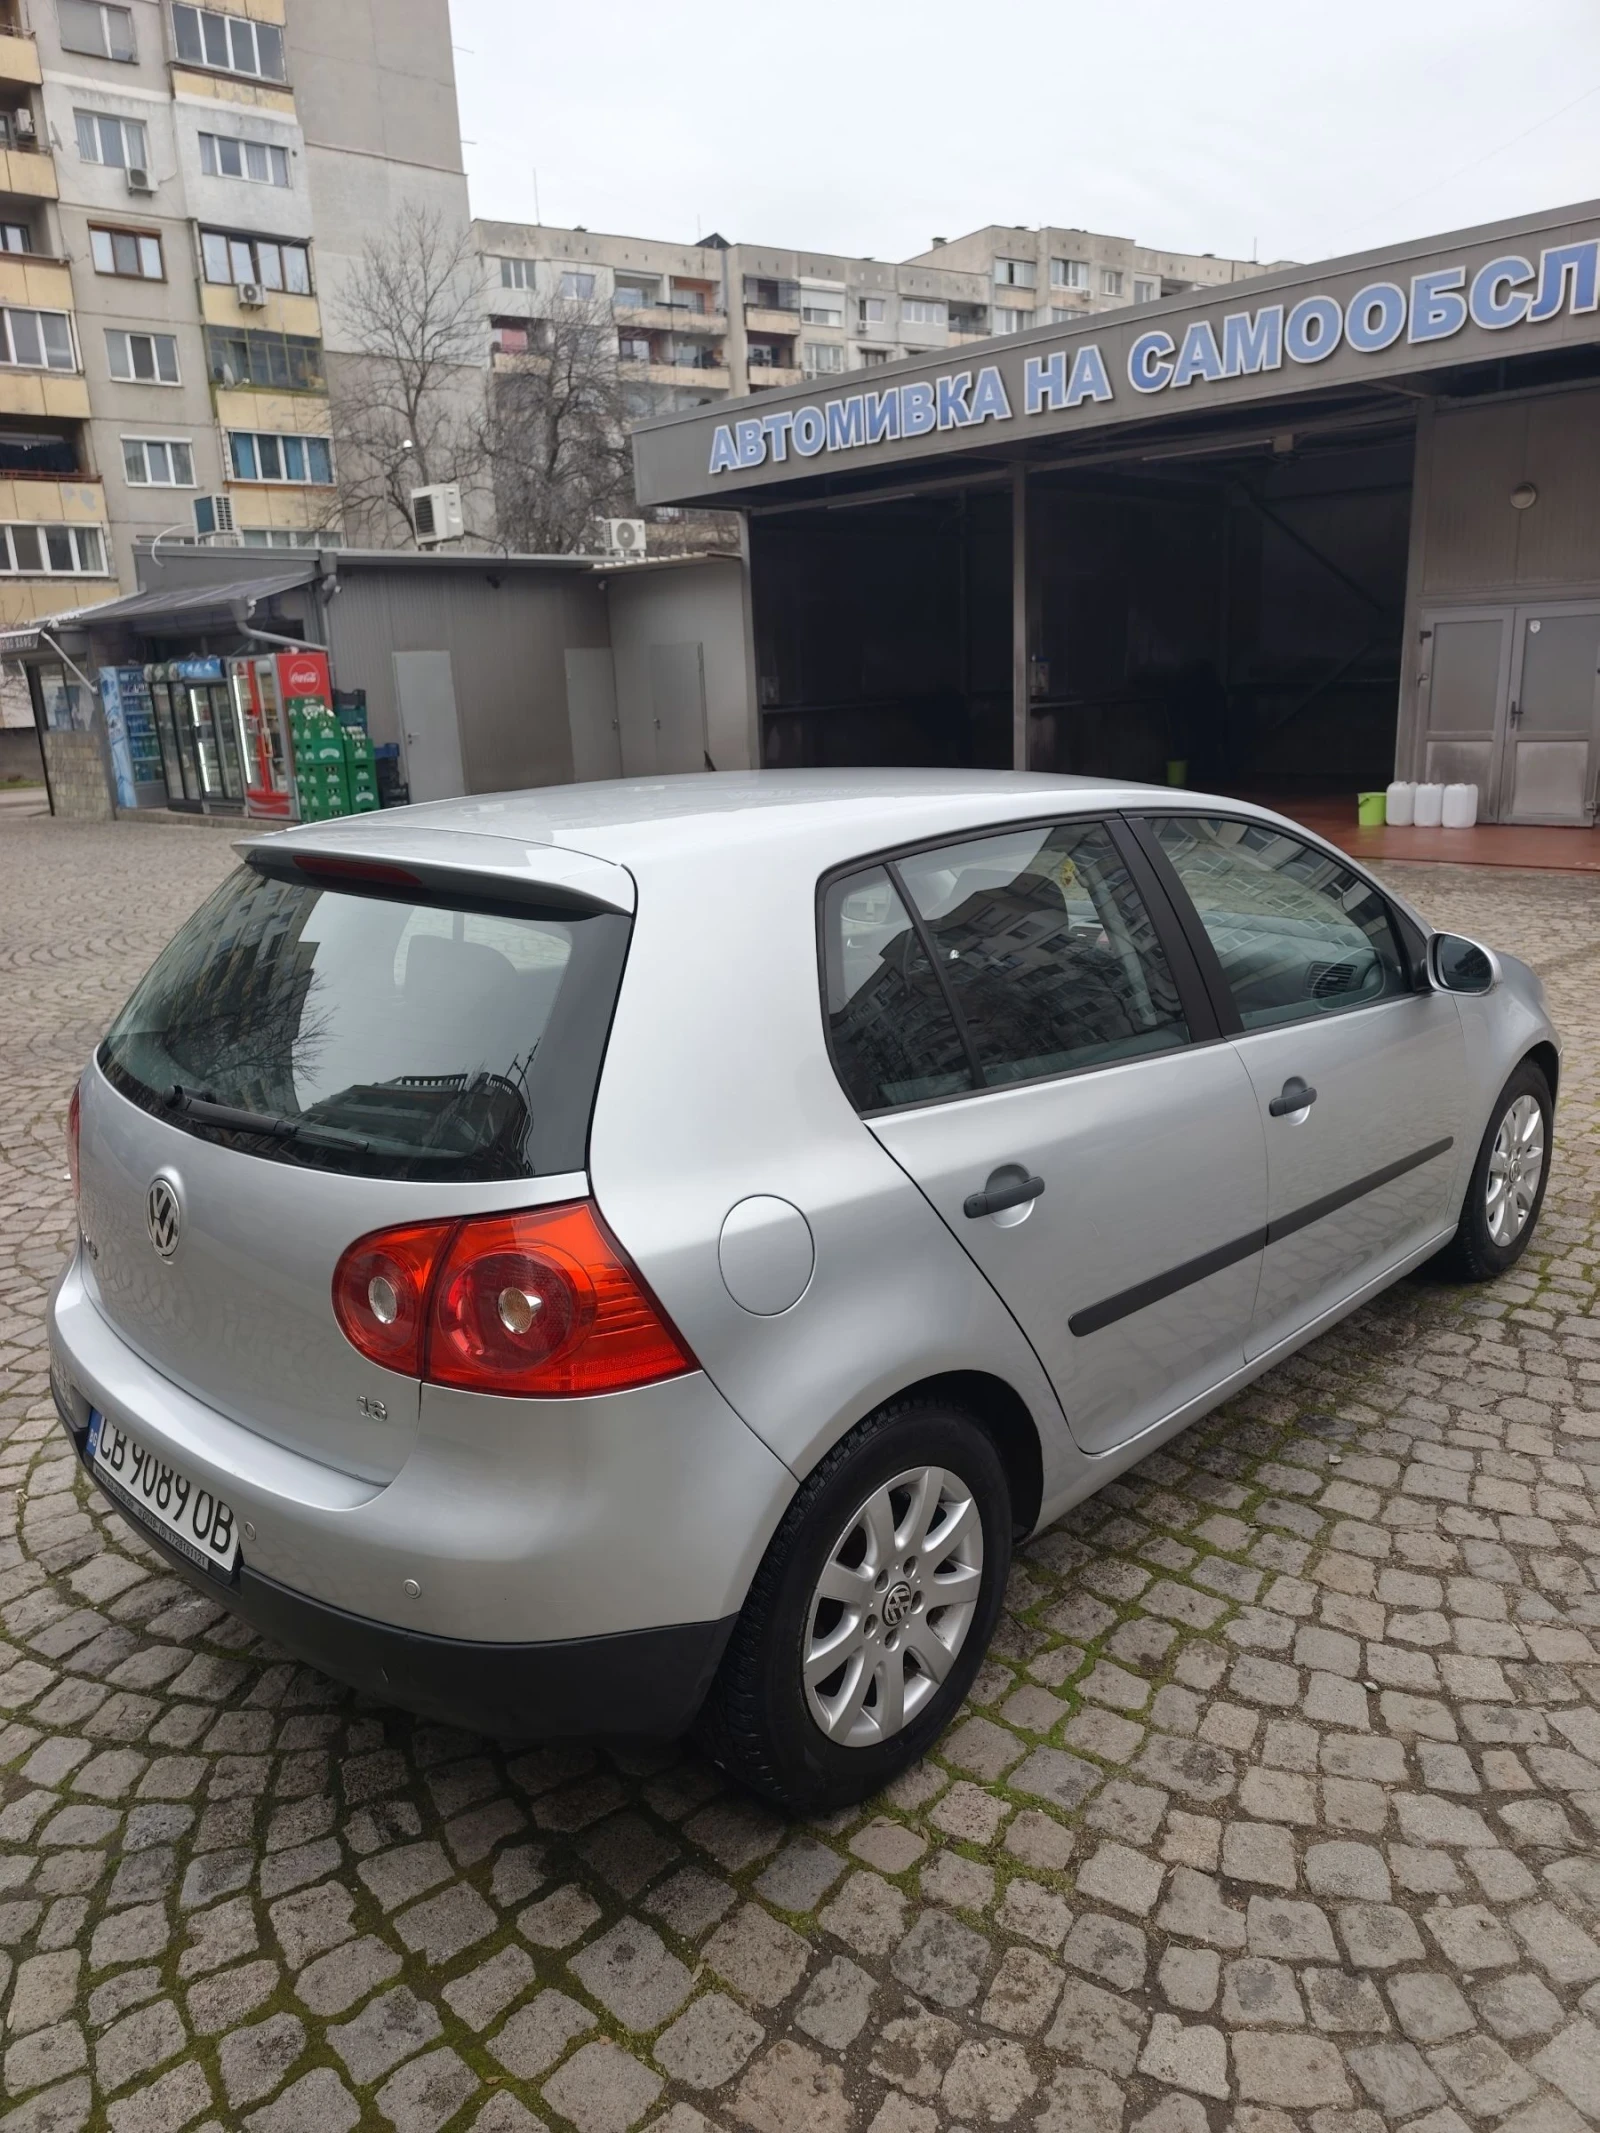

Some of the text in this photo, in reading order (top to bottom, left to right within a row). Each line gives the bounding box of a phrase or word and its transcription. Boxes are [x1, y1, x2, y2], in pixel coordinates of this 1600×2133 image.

[709, 238, 1600, 474] АВТОМИВКА НА САМООБСЛ
[148, 1180, 179, 1254] VW
[100, 1418, 234, 1554] CB 9089 OB
